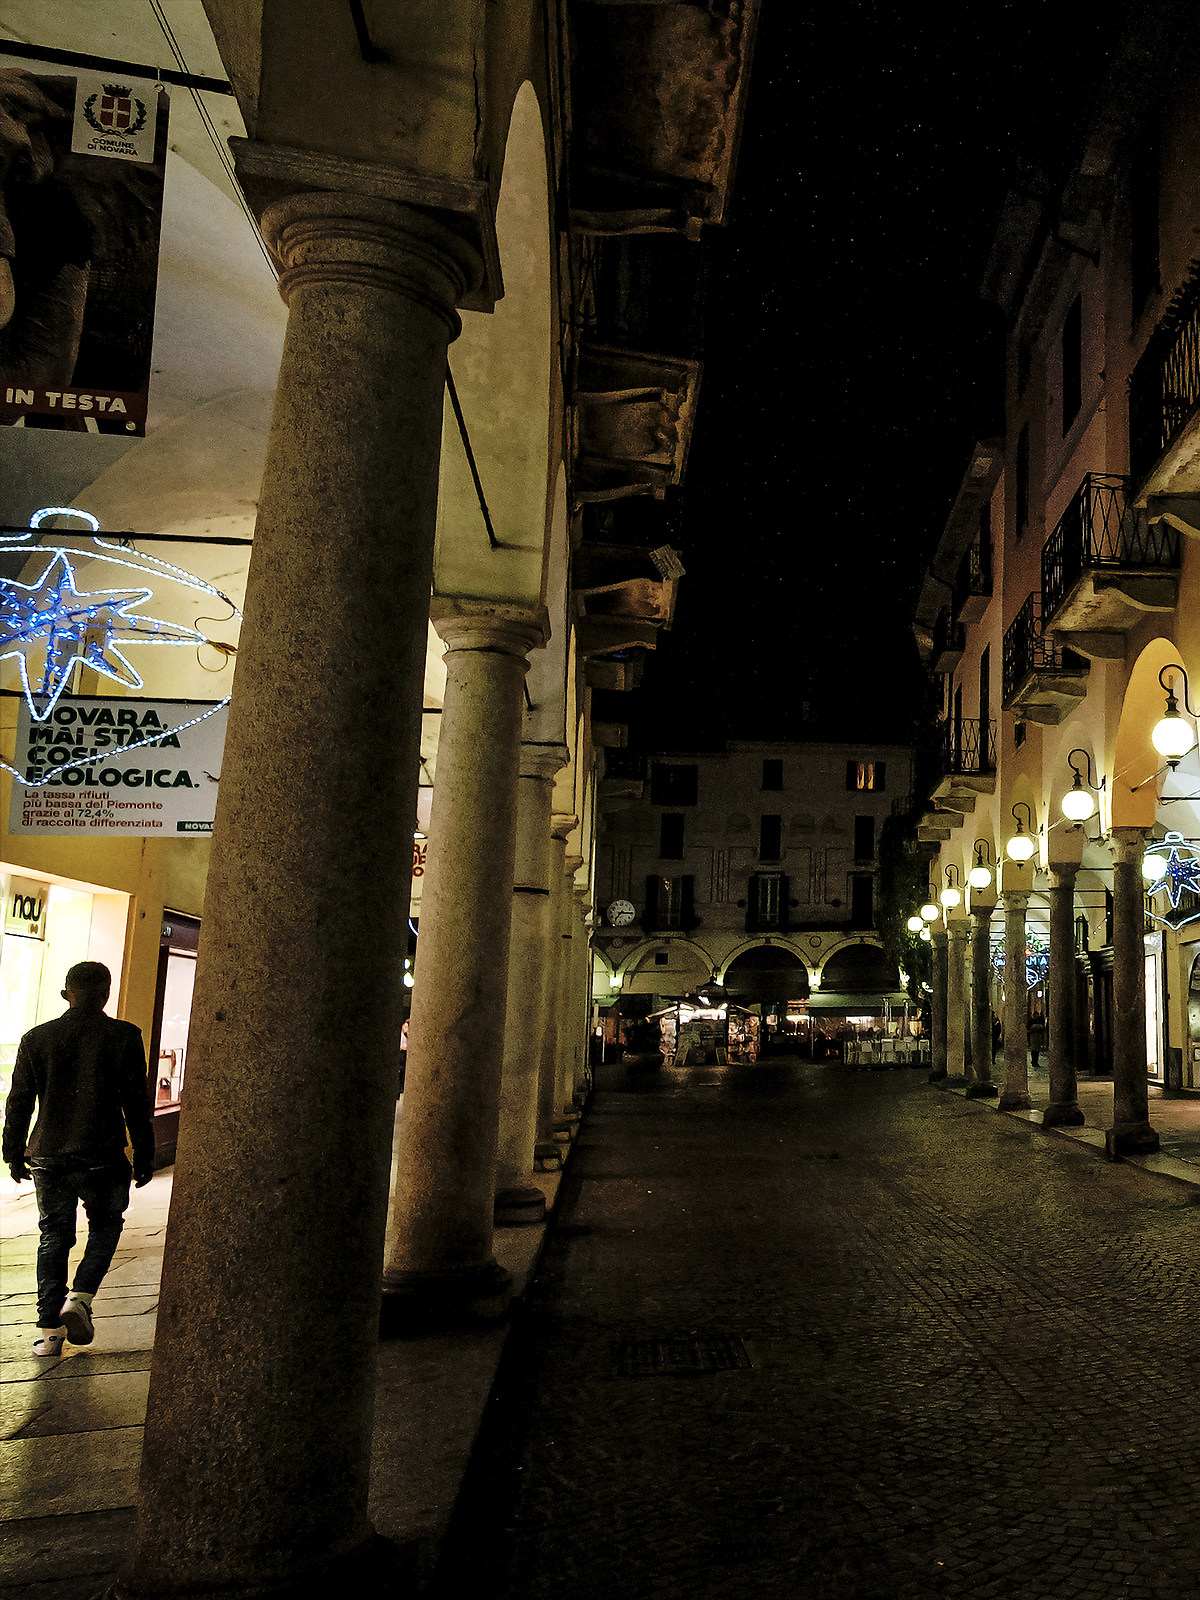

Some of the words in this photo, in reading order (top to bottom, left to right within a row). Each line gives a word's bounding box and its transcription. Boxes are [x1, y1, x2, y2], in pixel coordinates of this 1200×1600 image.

[87, 143, 97, 151] DI
[100, 145, 138, 156] NOVARA
[92, 138, 135, 149] COMUNE
[6, 388, 35, 406] IN
[45, 391, 127, 413] TESTA
[29, 726, 84, 746] MAI
[94, 727, 181, 748] STATA
[26, 766, 200, 788] ECOLOGICA.
[24, 789, 39, 799] La
[43, 790, 75, 799] tassa
[79, 790, 110, 800] rifiuti
[23, 799, 41, 809] più
[45, 799, 81, 809] bassa
[85, 800, 103, 809] del
[107, 800, 163, 810] Piemonte
[22, 809, 60, 819] grazie
[63, 809, 74, 818] al
[78, 809, 114, 819] 72,4%
[21, 817, 33, 827] di
[36, 818, 86, 827] raccolta
[89, 818, 163, 828] differenziata
[12, 893, 42, 922] nau
